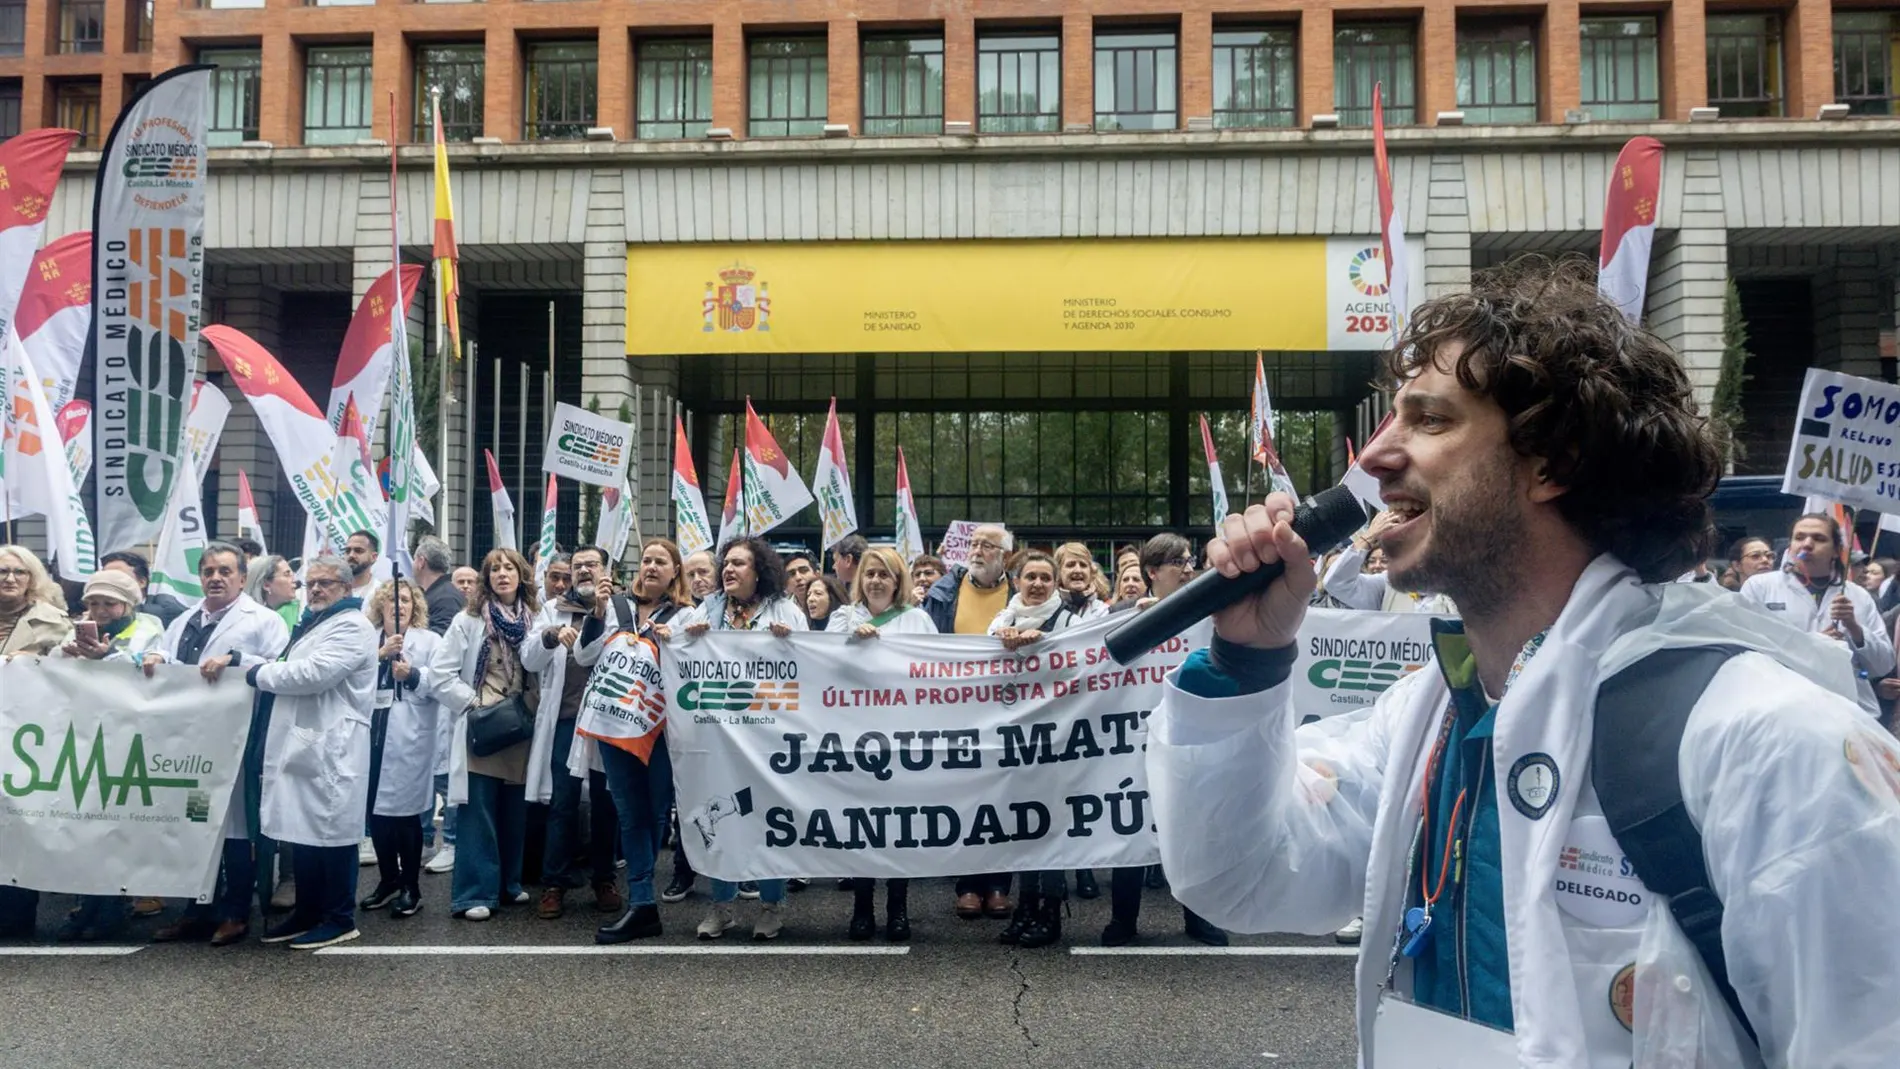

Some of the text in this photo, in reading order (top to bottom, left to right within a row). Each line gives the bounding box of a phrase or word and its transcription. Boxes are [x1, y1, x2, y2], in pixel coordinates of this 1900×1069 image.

[125, 140, 198, 157] SINDICATO MÉDICO
[123, 158, 196, 178] CESM
[1063, 298, 1117, 307] MINISTERIO
[1064, 310, 1076, 318] DE
[1079, 309, 1130, 318] DERECHOS
[1180, 308, 1231, 318] CONSUMO
[1345, 302, 1392, 313] AGEND
[864, 311, 917, 320] MINISTERIO
[864, 322, 921, 331] DE SANIDAD
[1071, 321, 1112, 330] AGENDA
[1346, 315, 1392, 332] 203
[102, 240, 126, 497] SINDICATO MÉDICO
[1814, 385, 1900, 426] SOMO
[563, 419, 624, 448] SINDICATO MÉDICO
[558, 433, 622, 465] CESM
[587, 464, 614, 477] Mancha
[1798, 443, 1874, 486] SALUD
[292, 473, 329, 523] Médico
[761, 489, 783, 520] Médico
[1310, 637, 1436, 662] SINDICATO MÉDIC
[678, 656, 798, 680] SINDICATO MÉDICO
[909, 655, 1041, 679] MINISTERIO
[1049, 651, 1078, 670] DE
[1307, 659, 1425, 692] CES
[676, 681, 799, 711] CESM
[822, 686, 908, 708] ÚLTIMA
[915, 682, 1046, 705] PROPUESTA
[1053, 678, 1080, 698] DE
[1330, 693, 1364, 705] Castilla
[608, 705, 648, 732] Mancha
[694, 715, 722, 725] Castilla
[729, 715, 740, 725] La
[742, 715, 776, 725] Mancha
[769, 711, 1151, 781] JAQUE MAT
[3, 720, 213, 812] SMA Sevilla
[764, 777, 1157, 848] SANIDAD PÚ
[1579, 862, 1613, 877] Médico
[1556, 880, 1642, 905] DELEGADO
